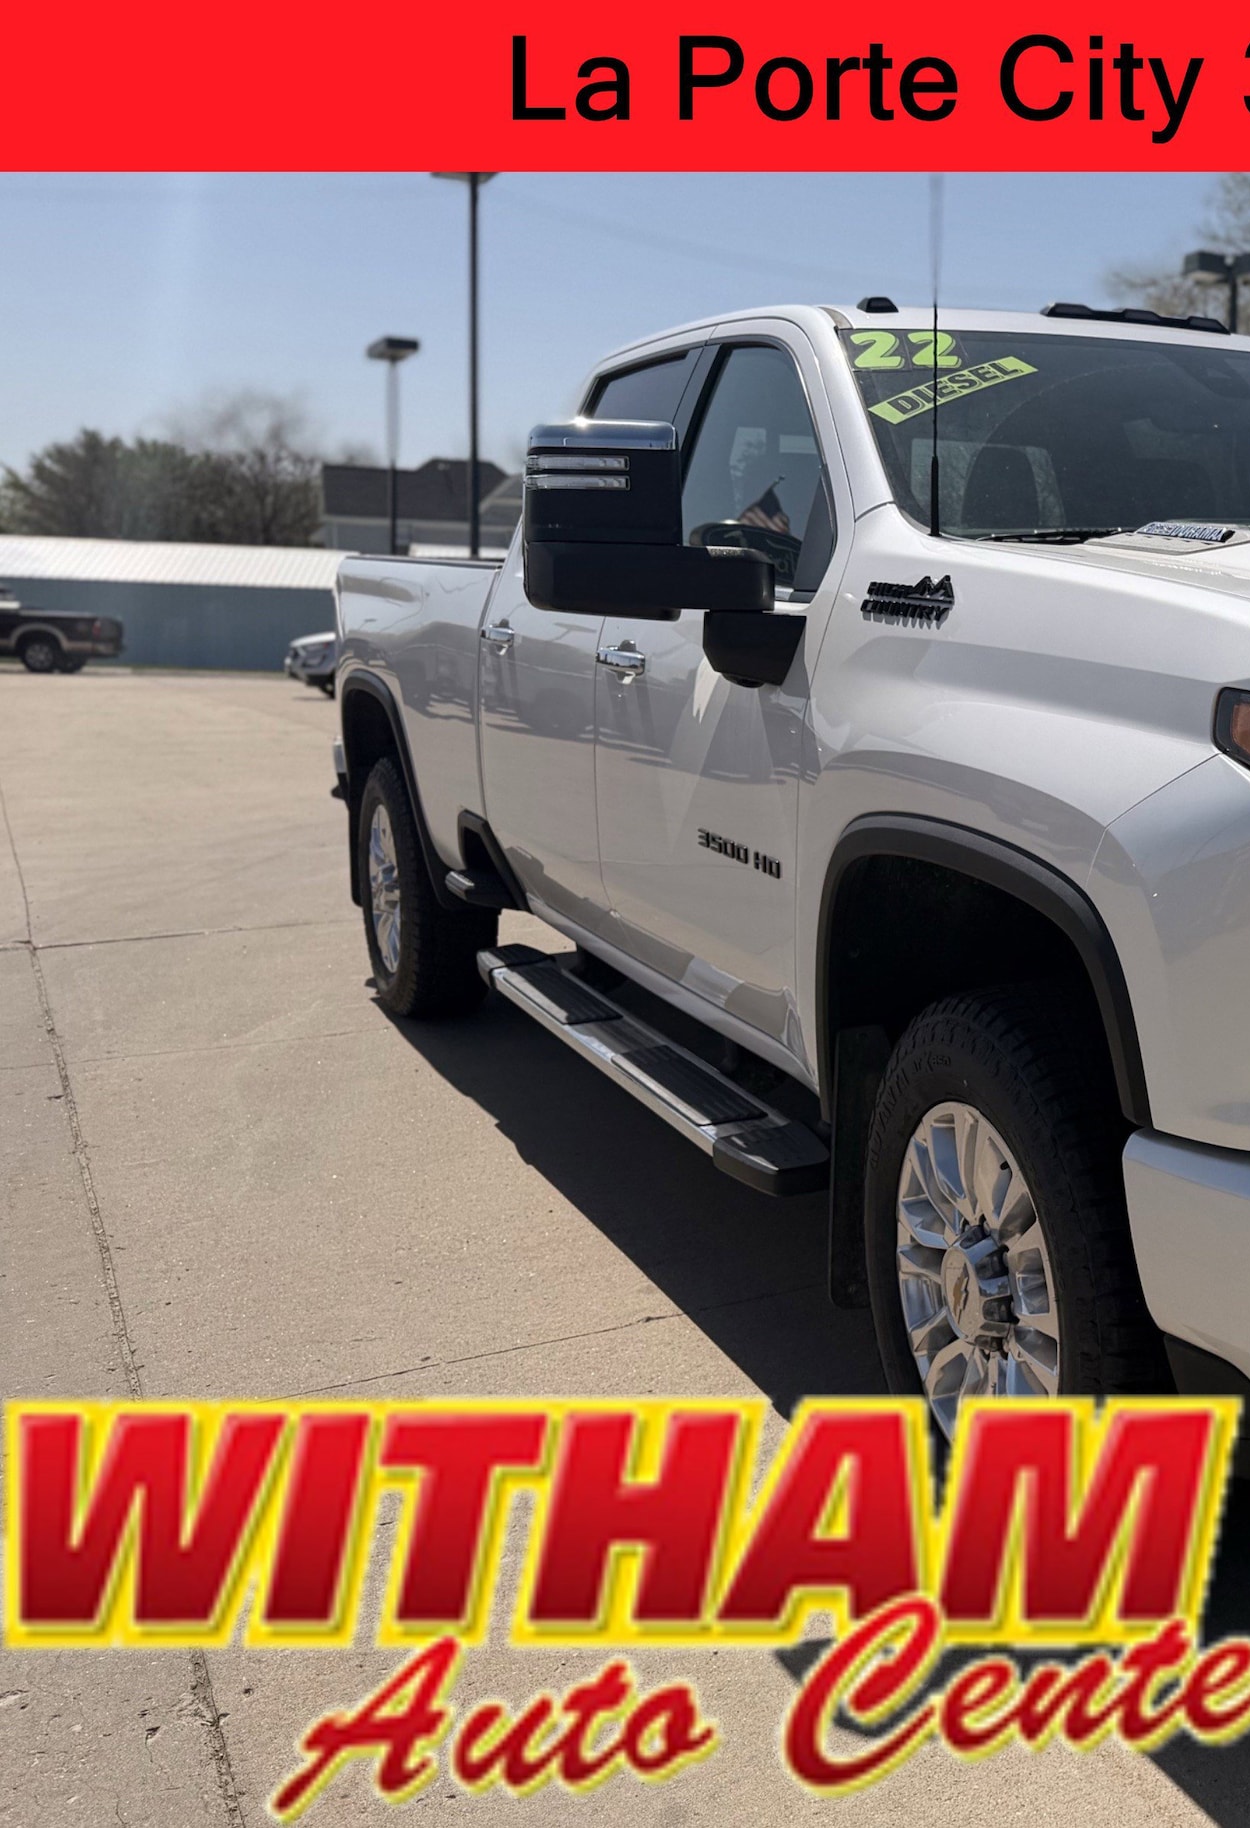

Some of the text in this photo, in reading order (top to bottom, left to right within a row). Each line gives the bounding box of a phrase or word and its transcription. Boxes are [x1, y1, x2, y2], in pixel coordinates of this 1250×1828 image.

[850, 331, 962, 370] 22
[886, 361, 1024, 415] DIESEL
[698, 827, 781, 879] 3500 HD
